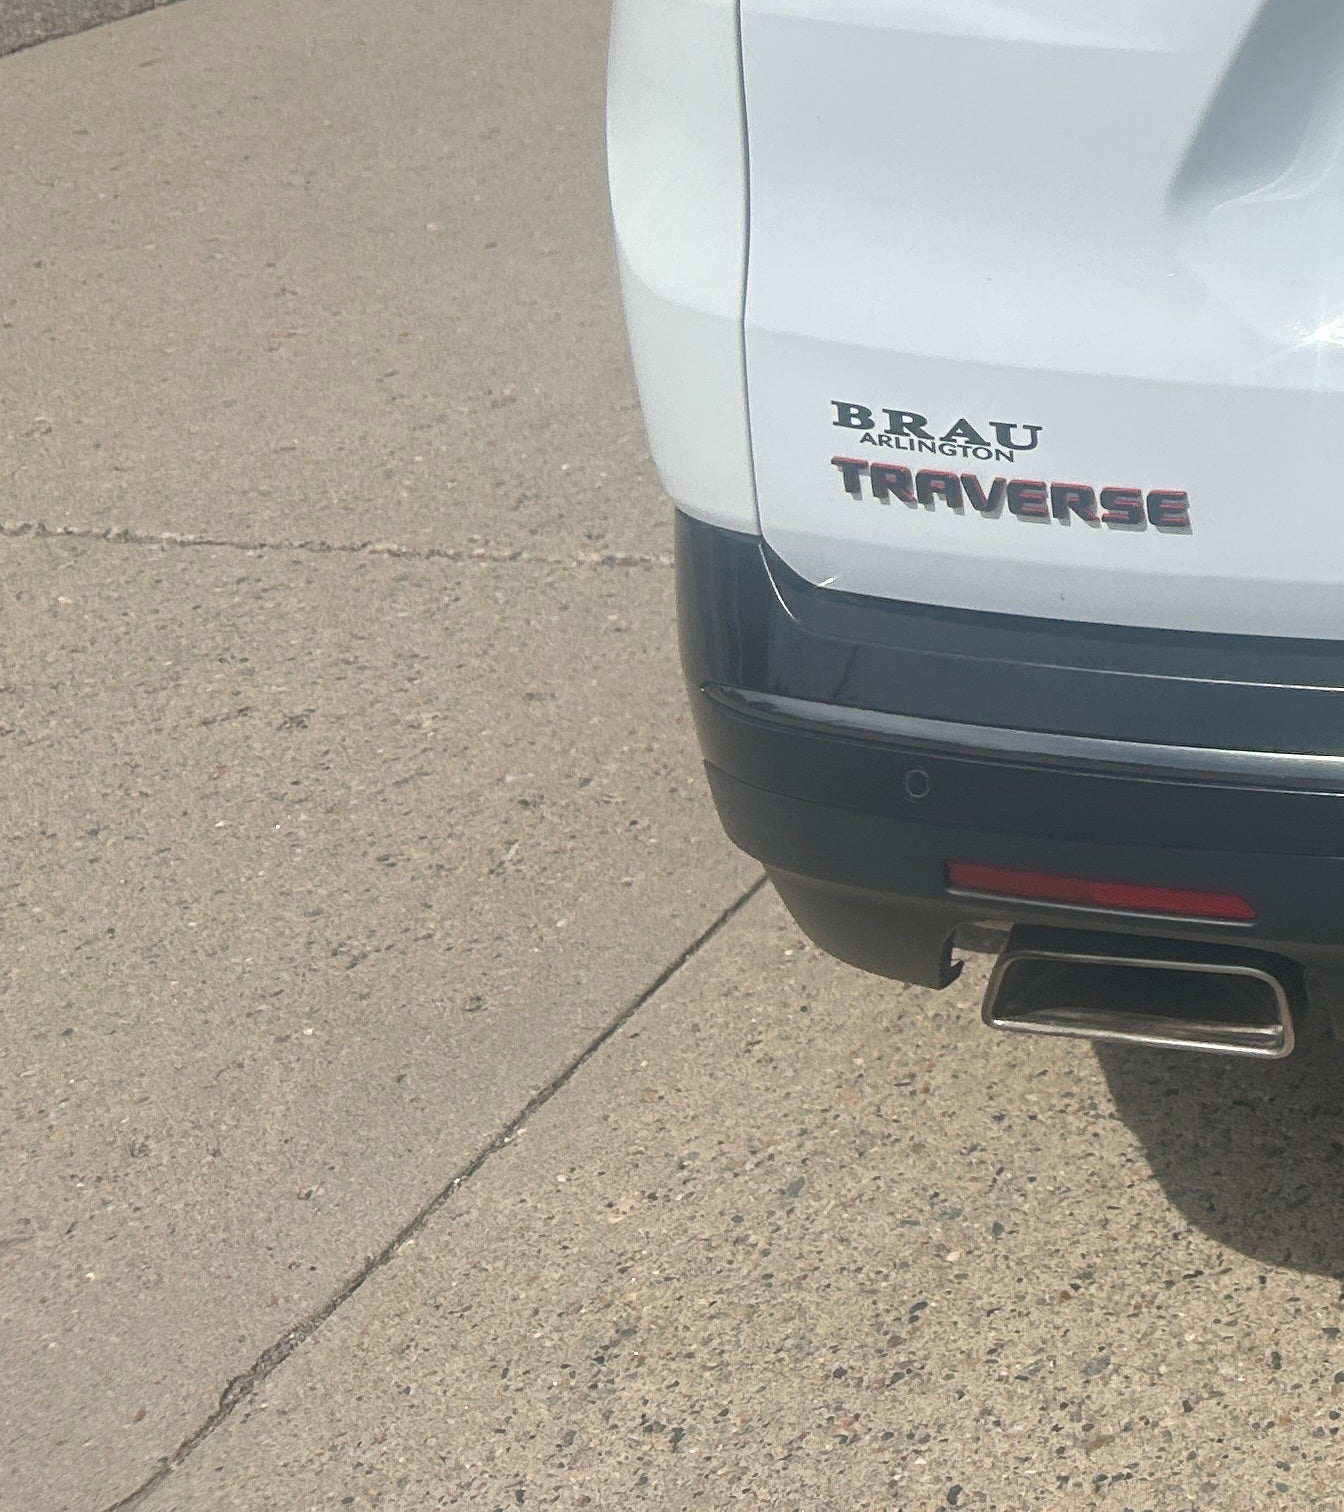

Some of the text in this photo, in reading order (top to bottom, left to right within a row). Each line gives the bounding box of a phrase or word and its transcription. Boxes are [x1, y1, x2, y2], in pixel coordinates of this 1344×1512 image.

[830, 400, 1043, 452] BRAU
[859, 432, 1015, 464] ARLINGTON
[830, 455, 1192, 529] TRAVERSE
